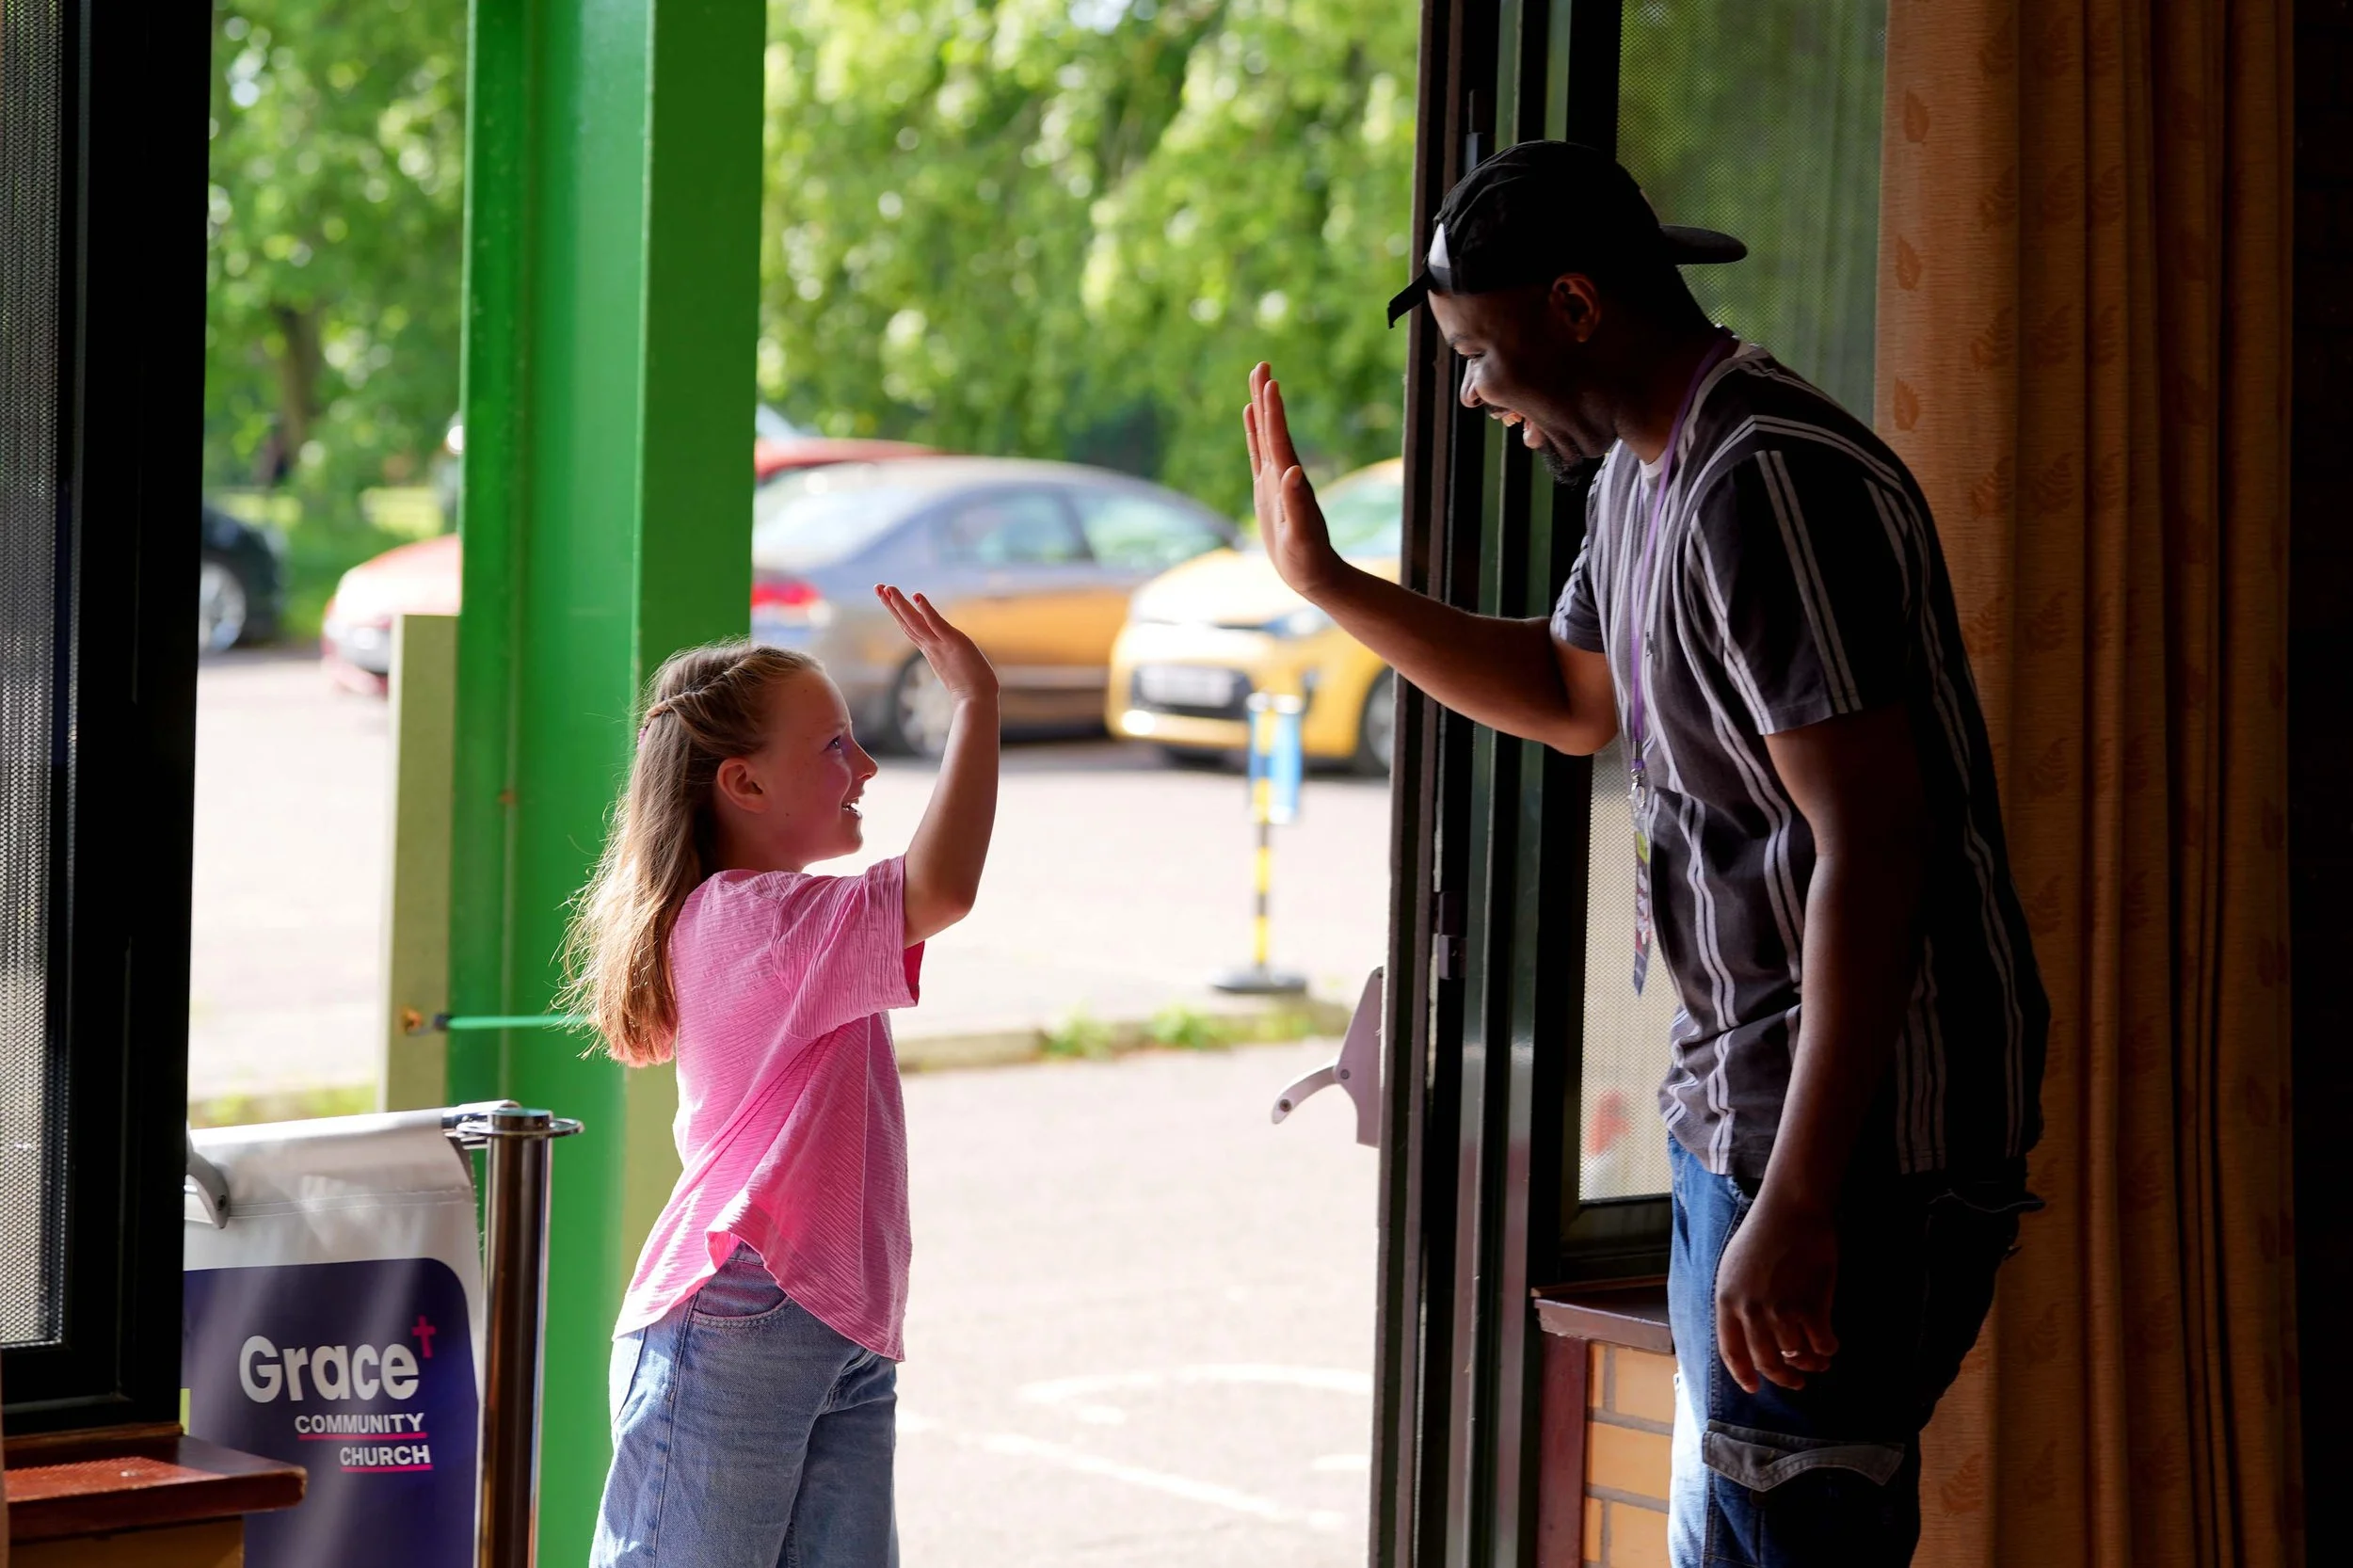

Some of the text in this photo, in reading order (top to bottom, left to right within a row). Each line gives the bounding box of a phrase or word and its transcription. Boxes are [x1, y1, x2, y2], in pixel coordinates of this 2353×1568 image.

[239, 1336, 419, 1403] Grace
[295, 1413, 424, 1433] COMMUNITY
[340, 1445, 430, 1465] CHURCH
